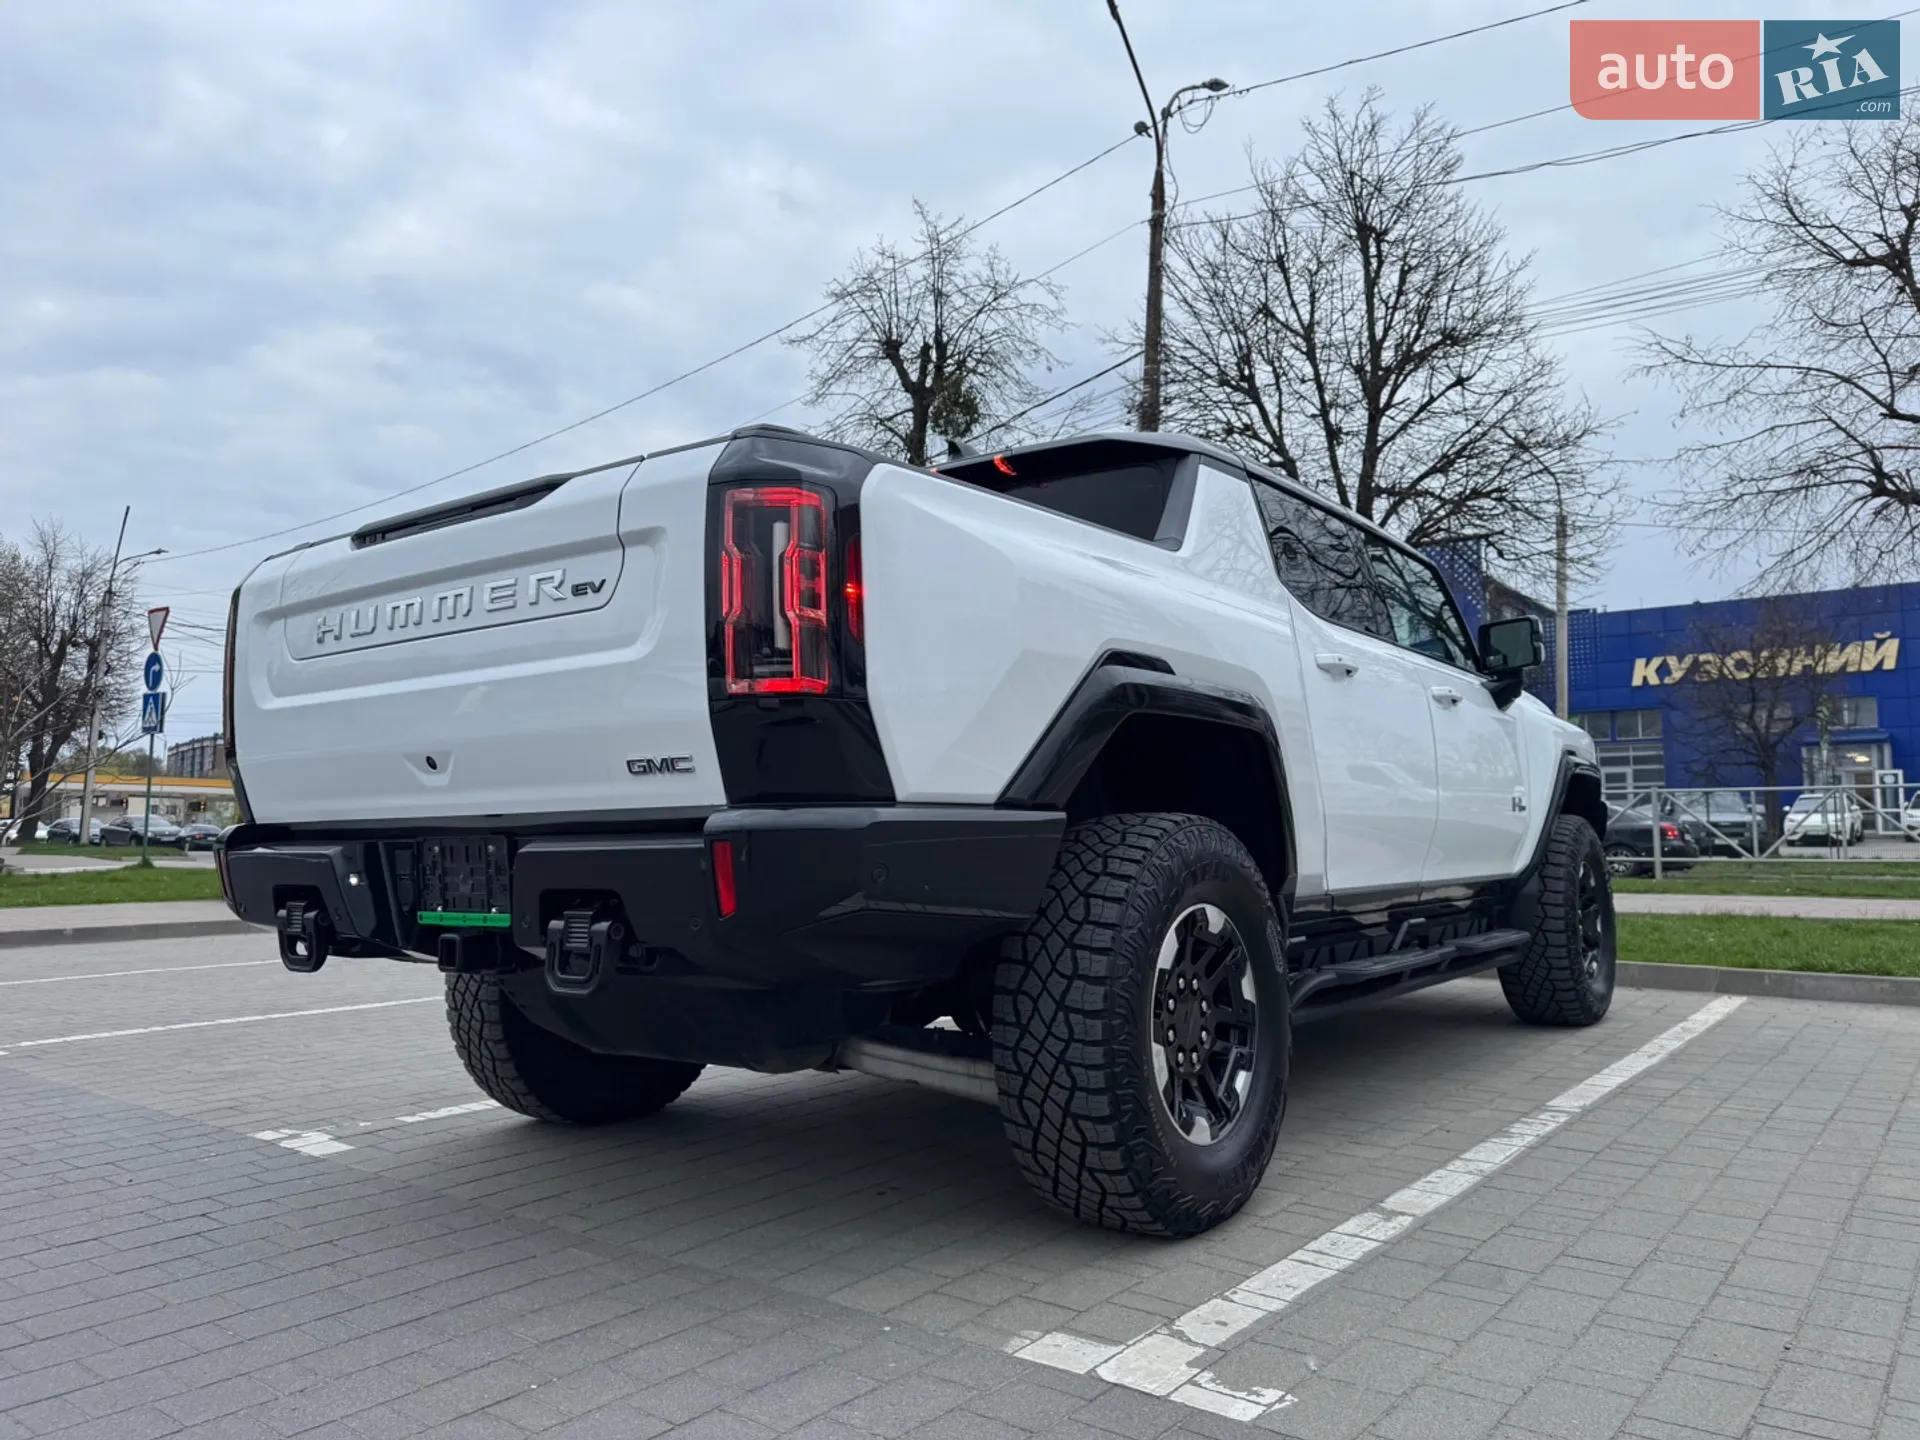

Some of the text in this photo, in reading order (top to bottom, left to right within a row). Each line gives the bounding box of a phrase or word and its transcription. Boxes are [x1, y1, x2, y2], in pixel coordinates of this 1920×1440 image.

[315, 568, 607, 645] HUMMER EV
[1631, 630, 1900, 687] КУЗОВНИЙ
[625, 754, 696, 777] GMC
